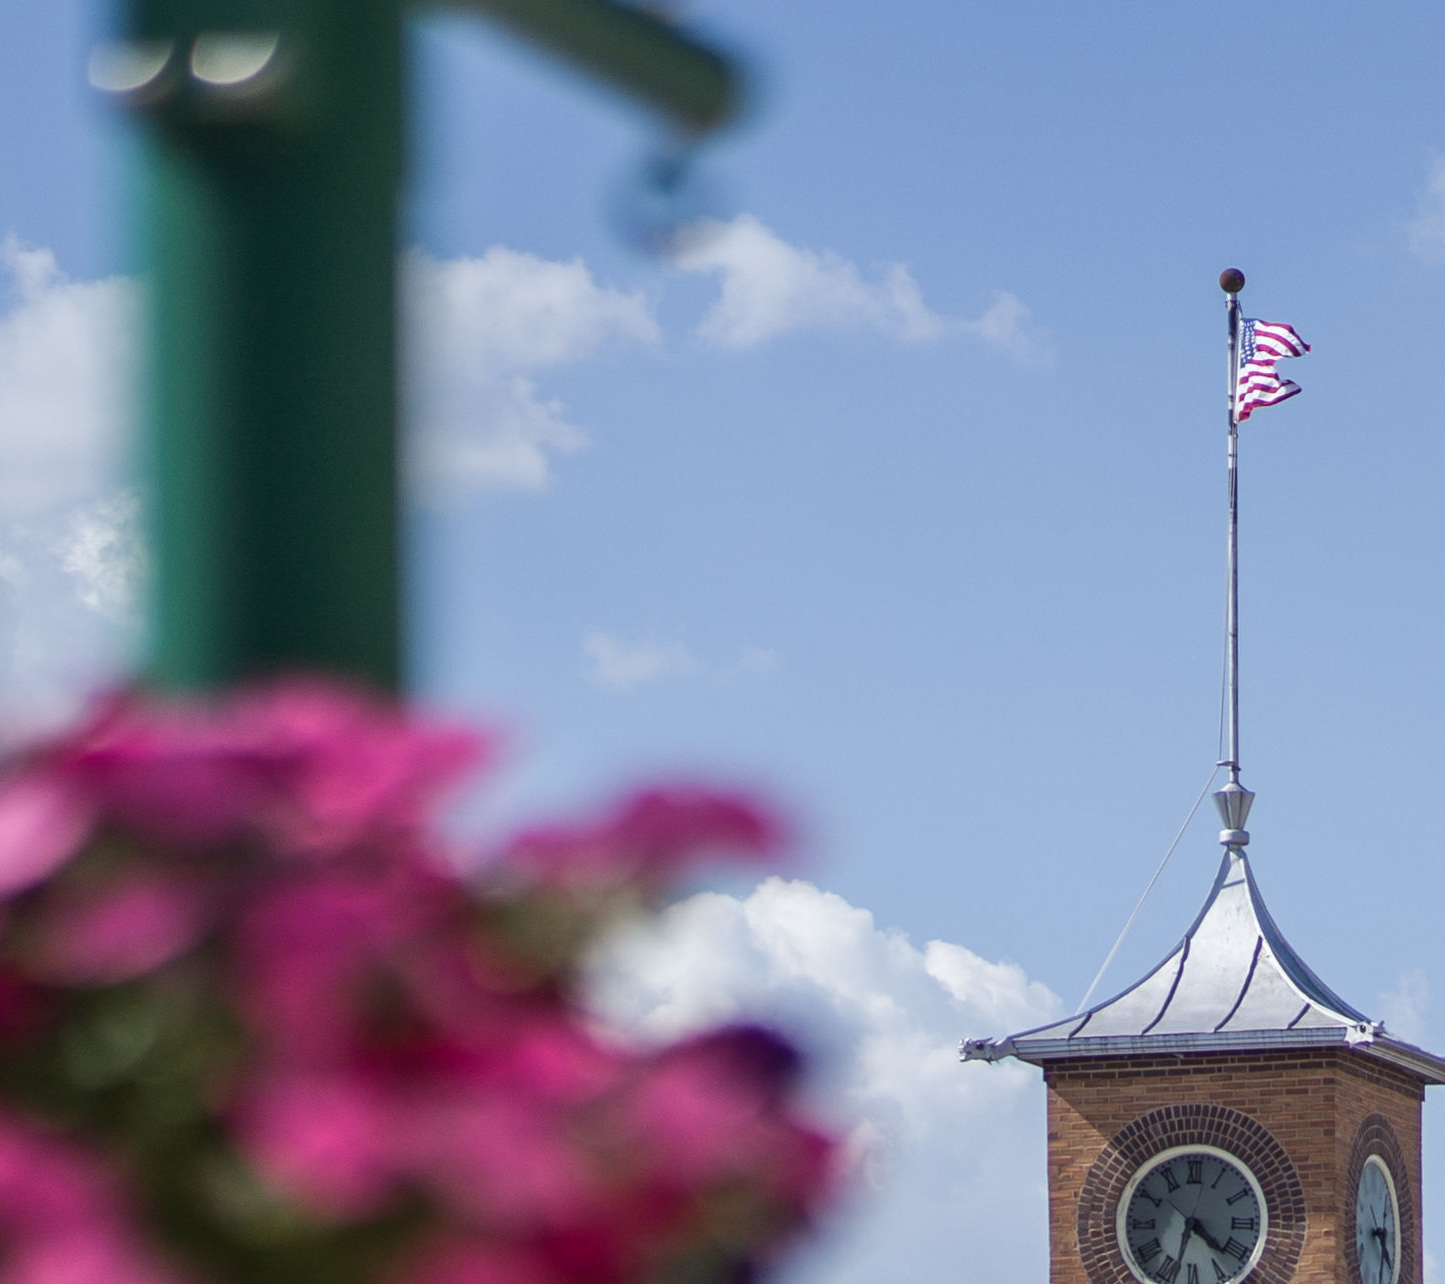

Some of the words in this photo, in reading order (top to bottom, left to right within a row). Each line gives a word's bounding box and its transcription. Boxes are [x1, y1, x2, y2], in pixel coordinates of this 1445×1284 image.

[1160, 1167, 1180, 1193] XI
[1186, 1160, 1202, 1184] XII
[1210, 1168, 1226, 1189] I
[1139, 1189, 1162, 1208] X
[1226, 1188, 1249, 1206] II
[1231, 1217, 1254, 1230] III
[1211, 1258, 1226, 1280] V
